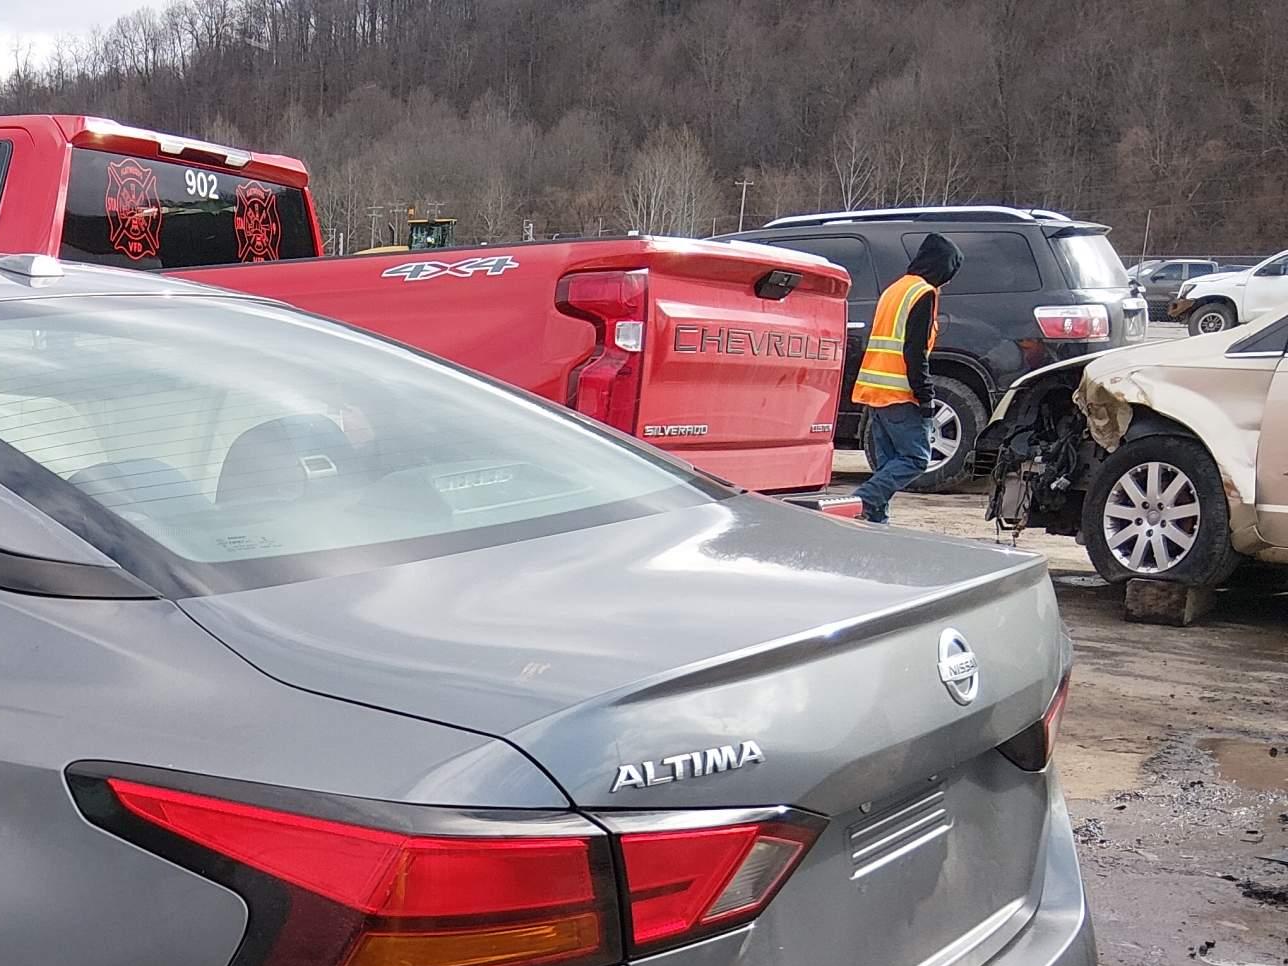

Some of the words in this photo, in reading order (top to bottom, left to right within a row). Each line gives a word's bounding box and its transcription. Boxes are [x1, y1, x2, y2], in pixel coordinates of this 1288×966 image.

[185, 169, 219, 199] 902
[673, 323, 842, 362] CHEVROLET
[643, 424, 709, 437] SILVERADO
[609, 740, 765, 793] ALTIMA
